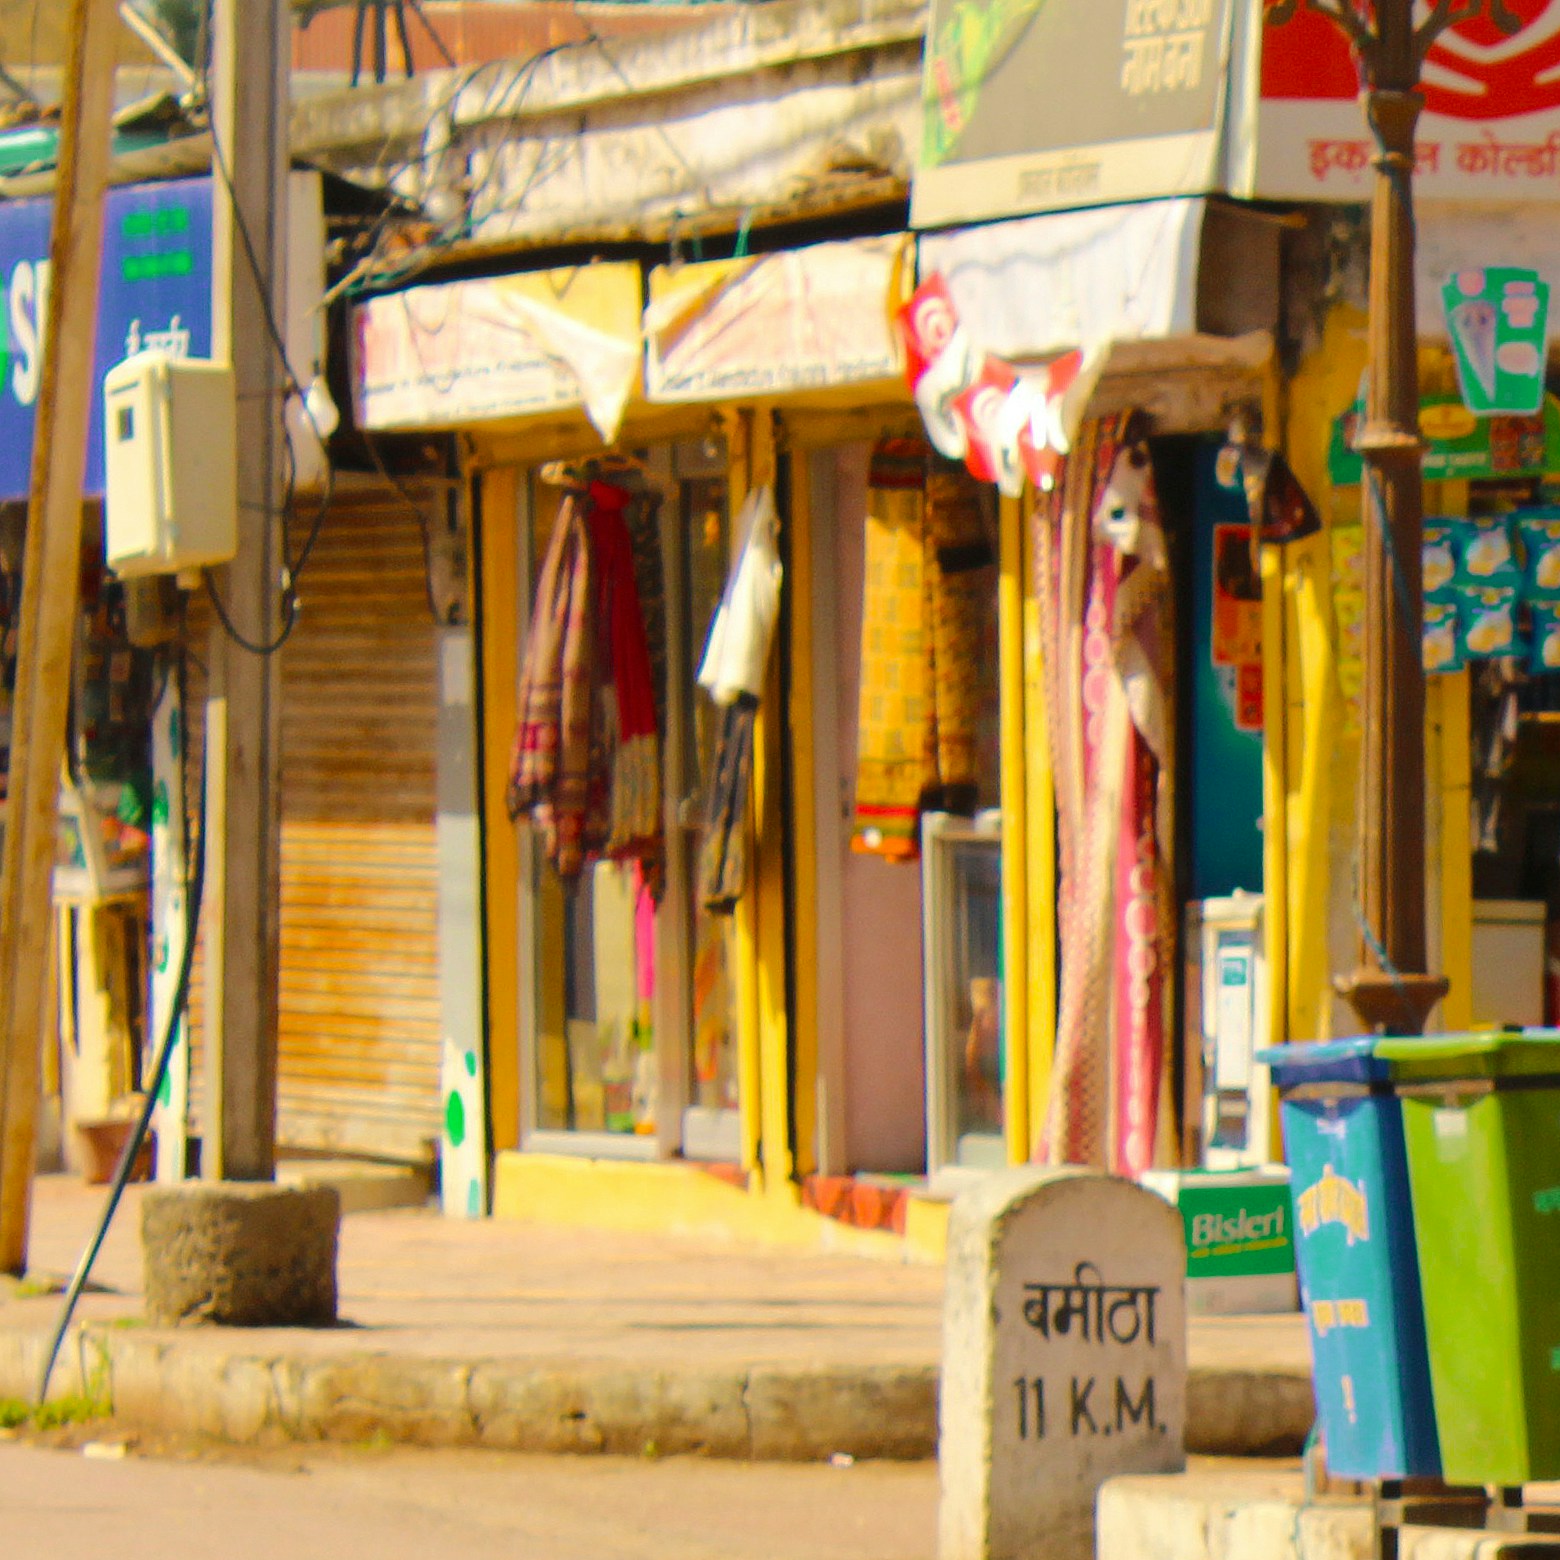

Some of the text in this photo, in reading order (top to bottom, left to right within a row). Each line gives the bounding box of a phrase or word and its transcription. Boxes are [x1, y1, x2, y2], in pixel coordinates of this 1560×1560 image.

[1192, 1205, 1285, 1248] Bisleri
[1023, 1260, 1161, 1347] बमीठा
[1013, 1375, 1169, 1441] 11 K.M.
